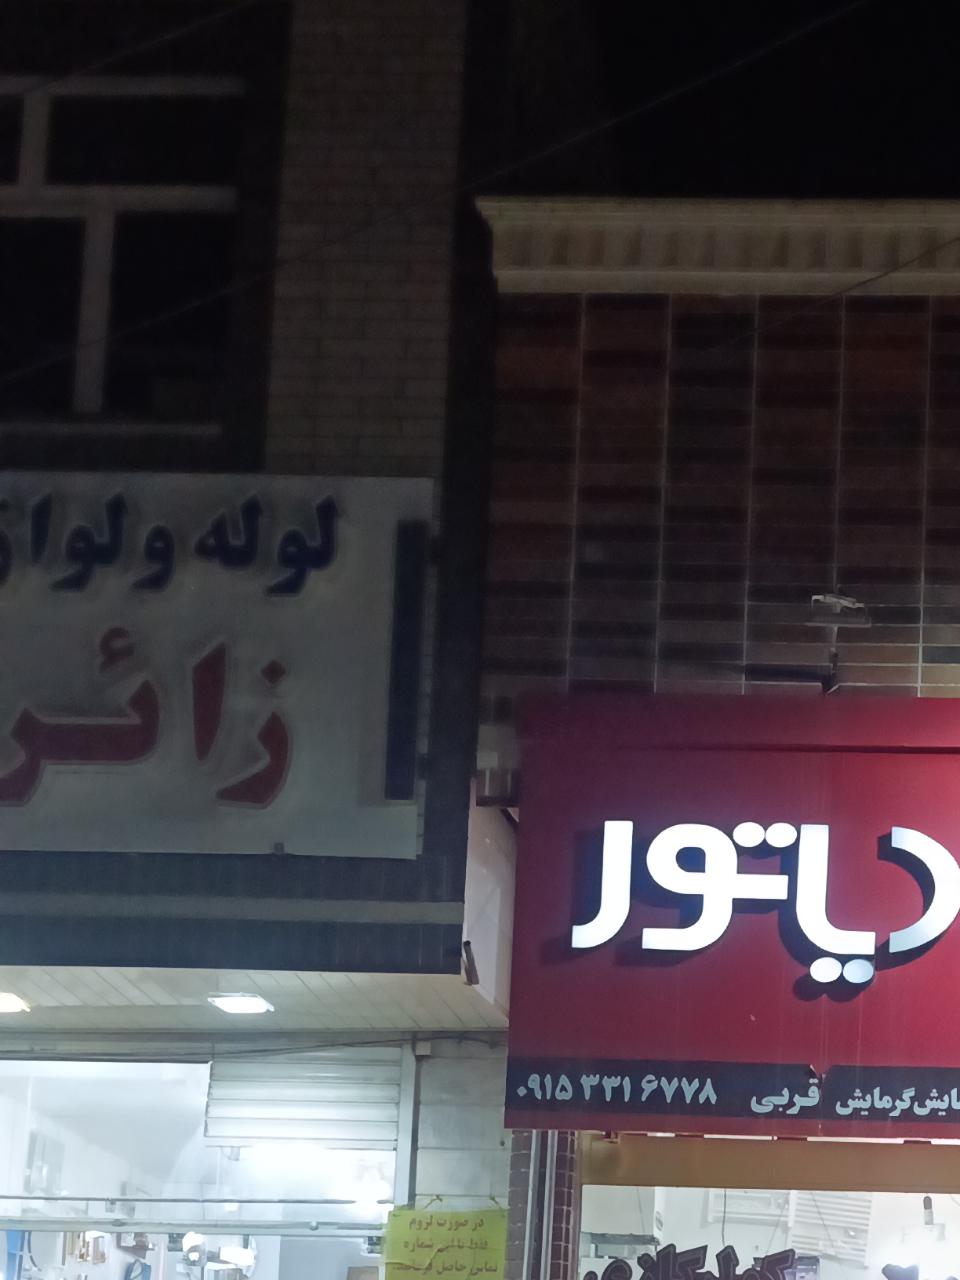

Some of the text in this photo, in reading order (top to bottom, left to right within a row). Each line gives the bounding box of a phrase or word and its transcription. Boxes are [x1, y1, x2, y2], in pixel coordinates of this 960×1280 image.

[194, 493, 338, 597] لوله
[516, 1073, 718, 1105] ۰۹۱۵ ۳۳۱ ۶۷۷۸
[835, 1086, 916, 1117] گرمایش
